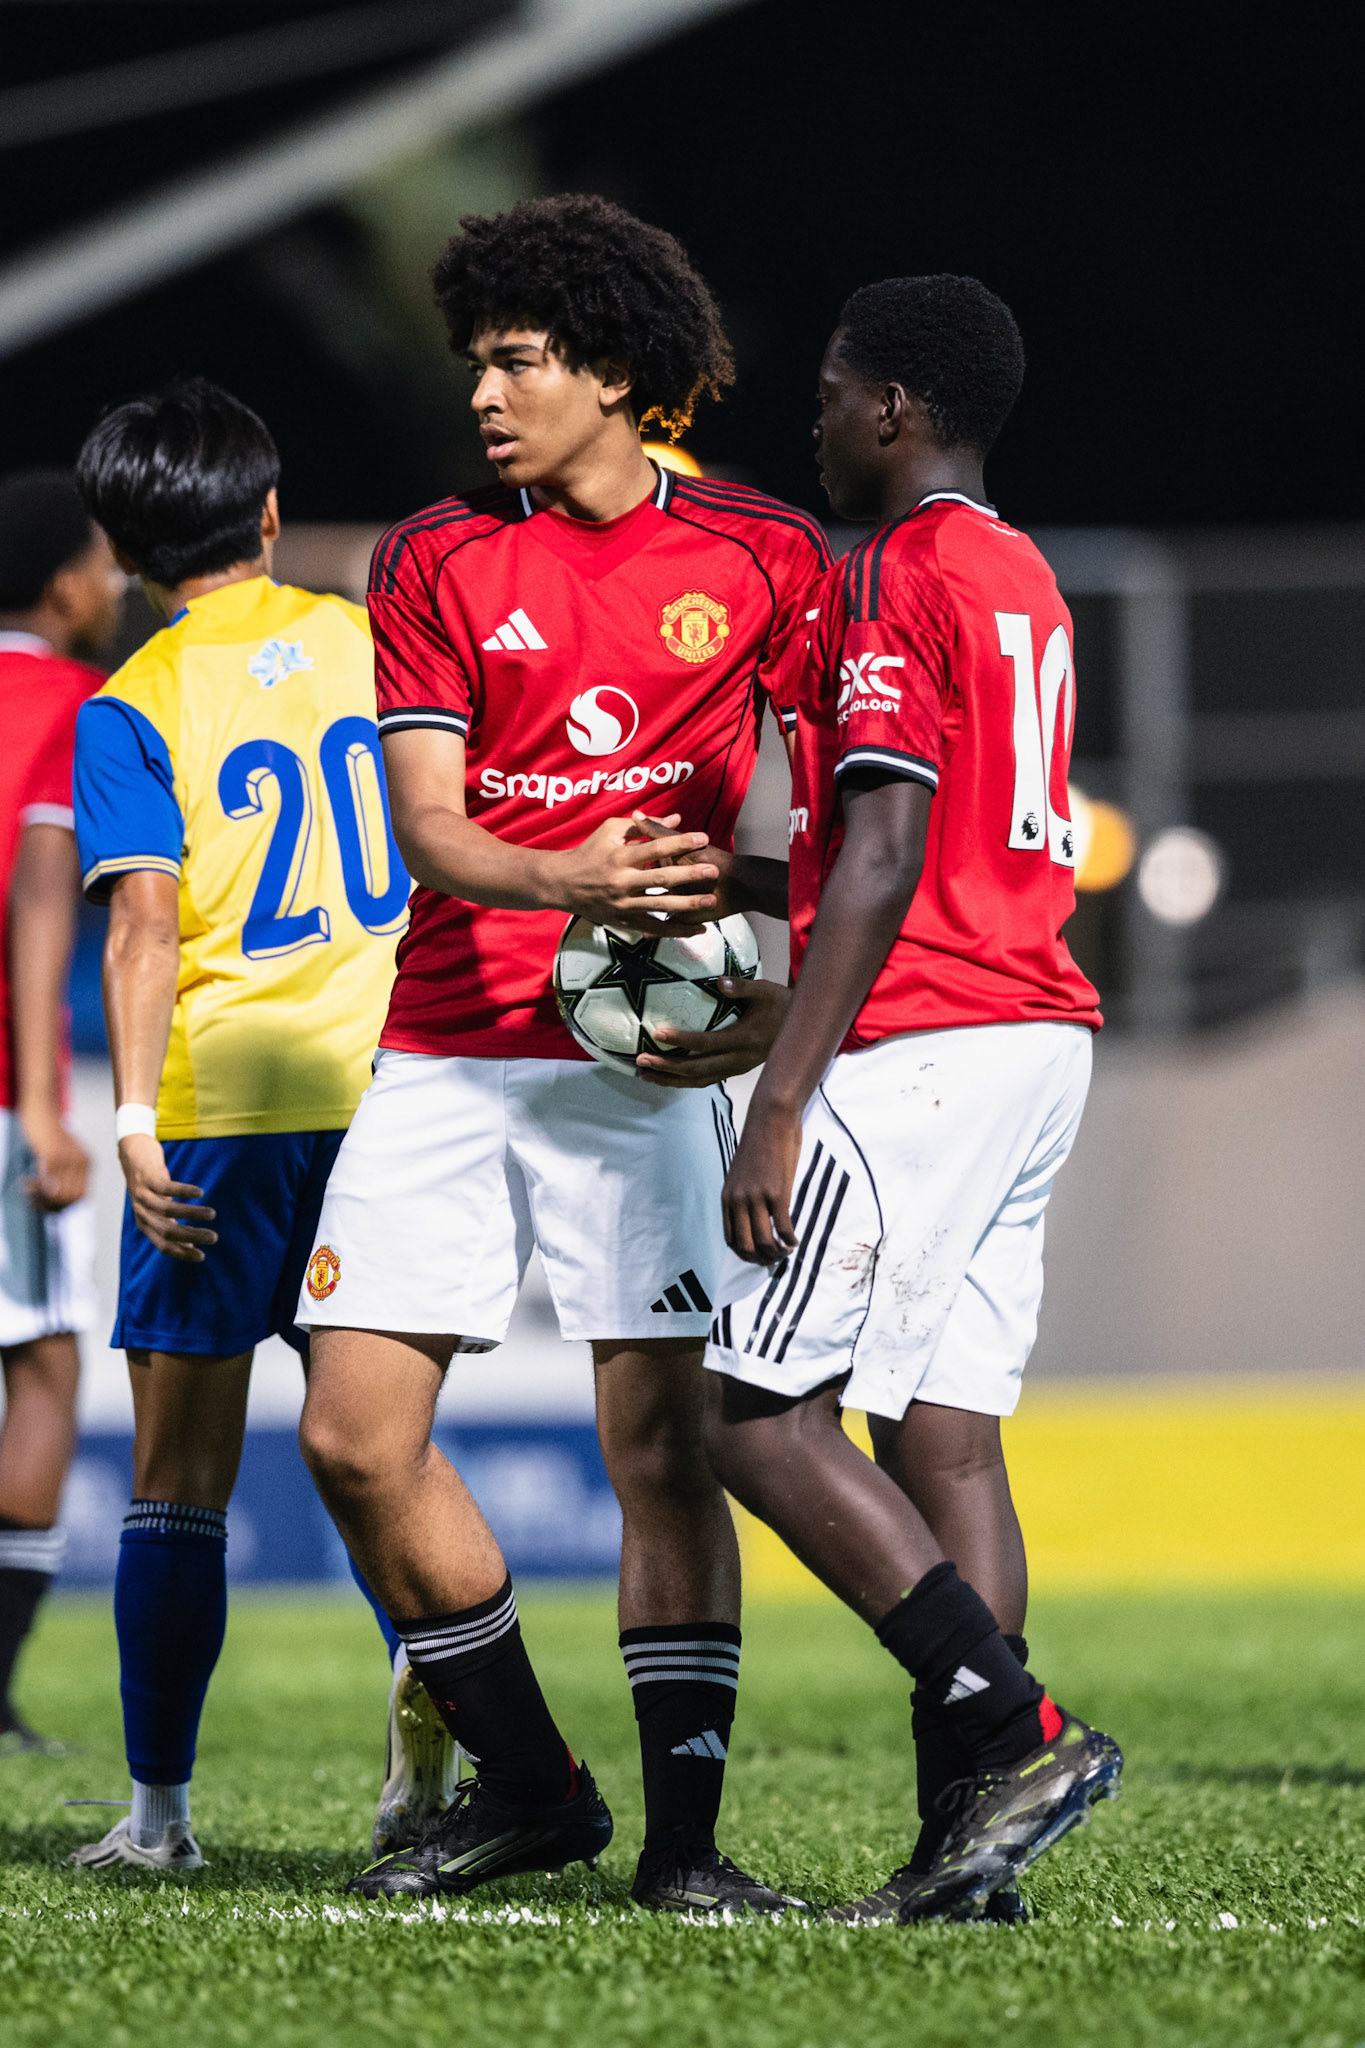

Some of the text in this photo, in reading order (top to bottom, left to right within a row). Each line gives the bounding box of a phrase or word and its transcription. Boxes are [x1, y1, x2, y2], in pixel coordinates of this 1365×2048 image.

[667, 598, 722, 620] MANCHESTER
[676, 646, 716, 658] UNITED
[994, 611, 1075, 869] 10
[479, 761, 695, 809] Snapdragon
[217, 715, 410, 961] 20
[311, 1287, 331, 1298] UNITED
